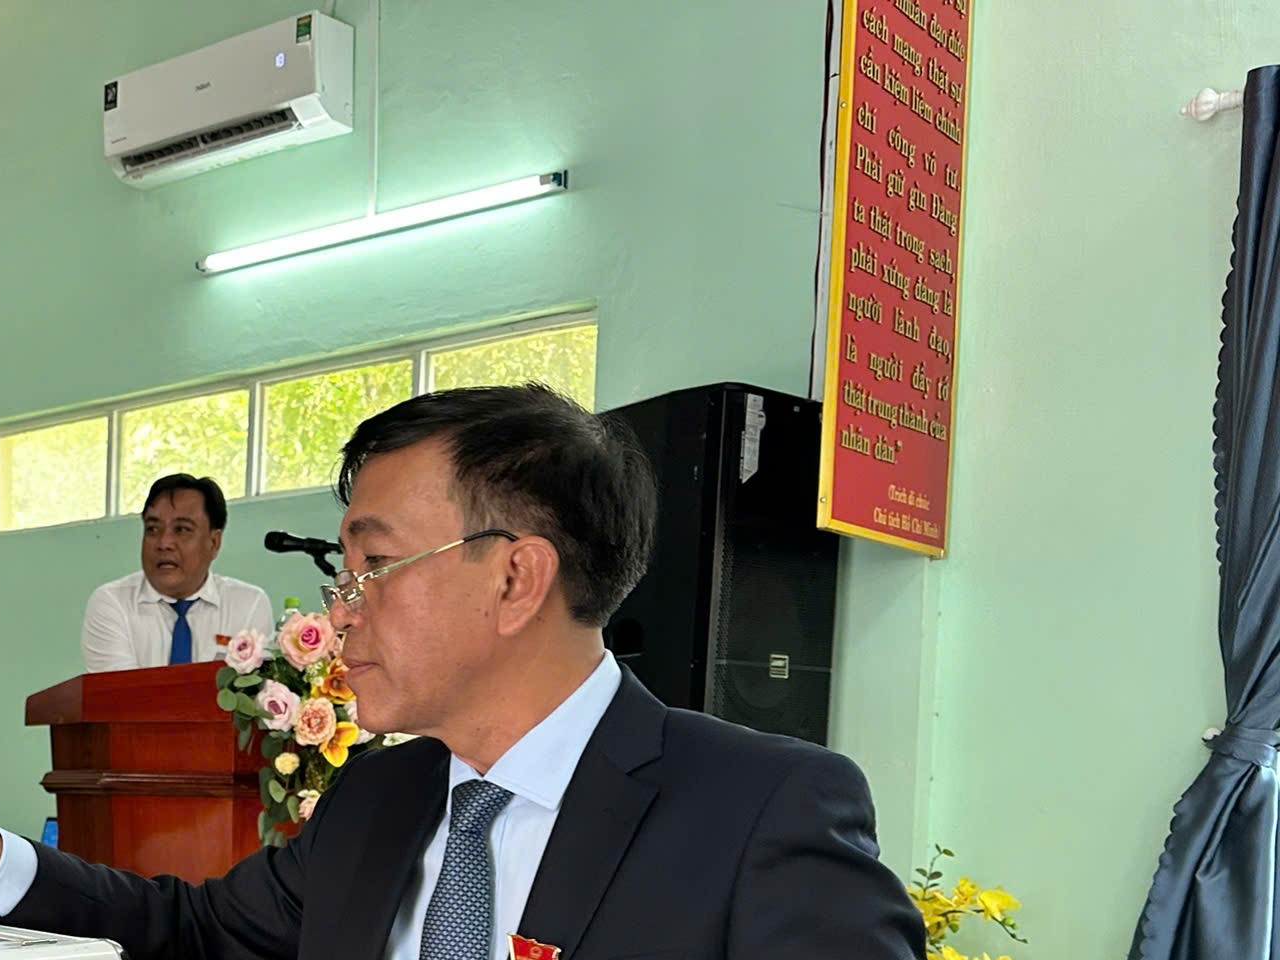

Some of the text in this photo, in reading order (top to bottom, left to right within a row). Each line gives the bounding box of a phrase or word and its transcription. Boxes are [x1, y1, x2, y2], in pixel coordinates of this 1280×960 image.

[862, 6, 889, 44] cách
[928, 56, 949, 95] thật
[950, 81, 963, 107] sự
[860, 45, 961, 145] cần kiệm liêm chính
[857, 101, 877, 134] chí
[887, 125, 916, 168] công
[924, 152, 937, 176] vô
[855, 143, 883, 184] Phải
[909, 181, 928, 211] gìn
[930, 193, 957, 236] Đảng
[853, 196, 866, 224] ta
[869, 205, 893, 242] thật
[895, 221, 926, 264] trong
[848, 291, 883, 322] người
[849, 242, 954, 317] phải xứng đáng là
[846, 332, 858, 364] là
[869, 351, 903, 382] người
[936, 375, 950, 401] tớ
[841, 423, 871, 456] nhân
[843, 378, 948, 441] thật trung thành của
